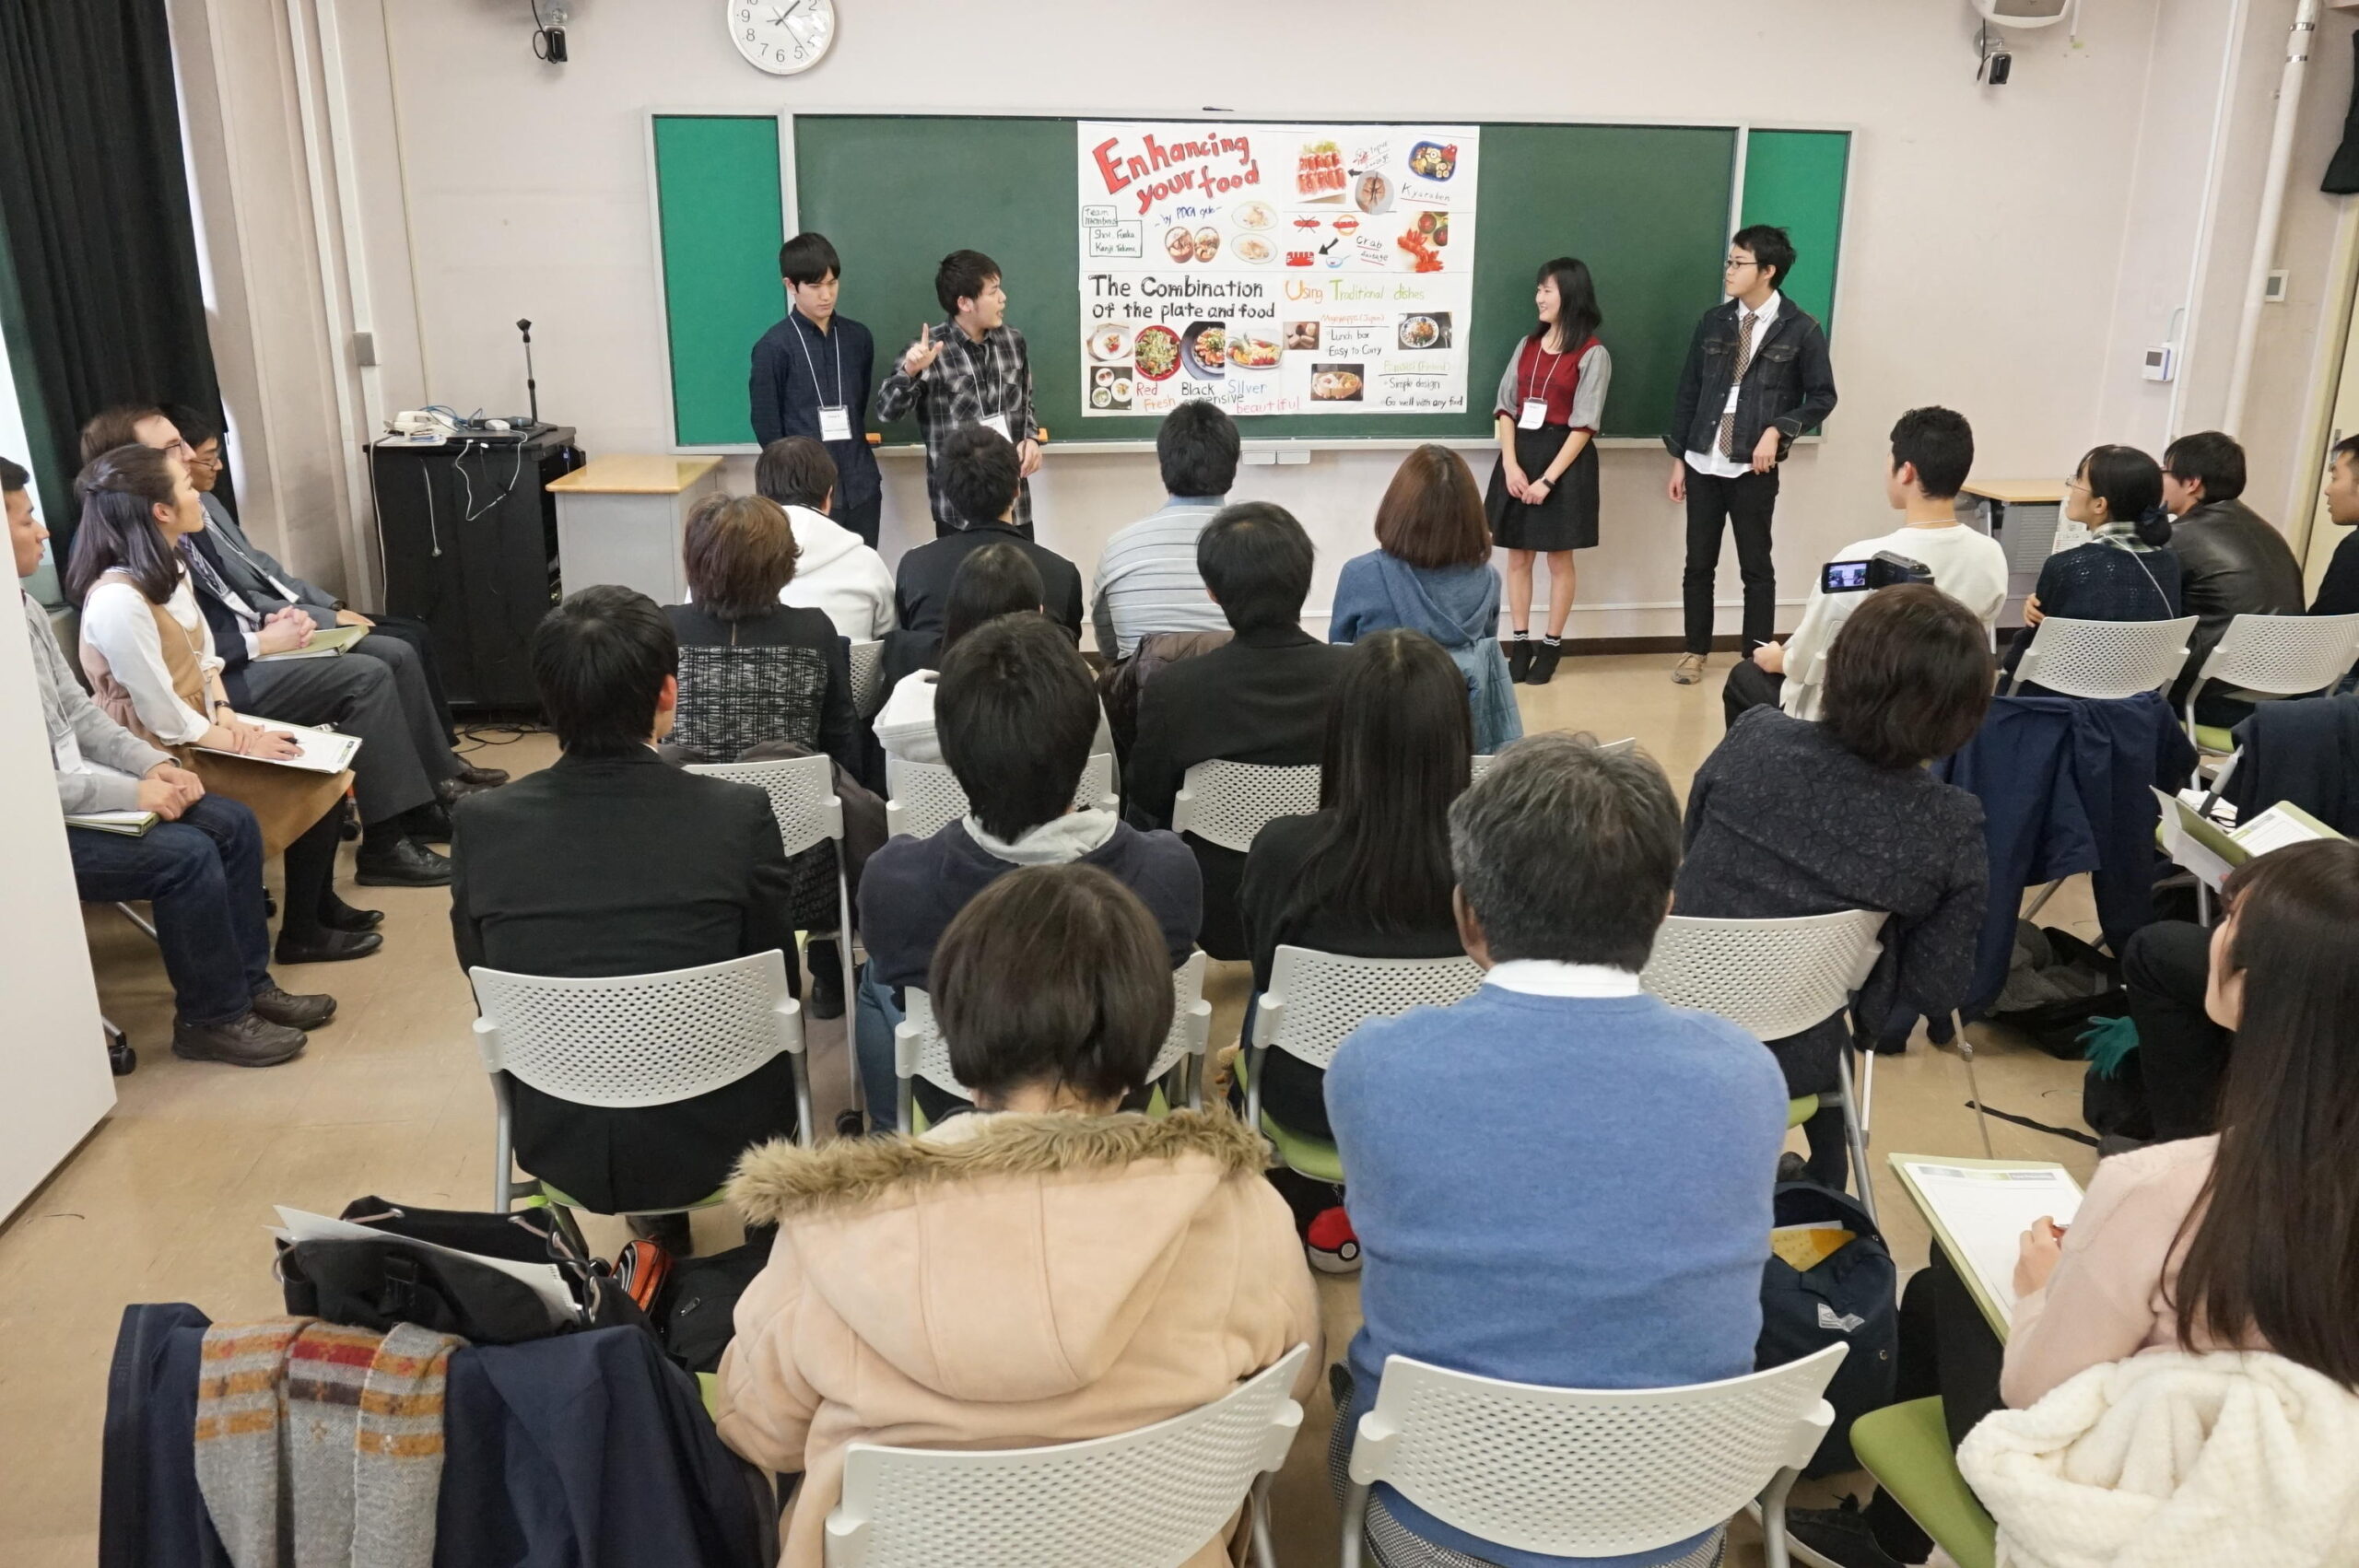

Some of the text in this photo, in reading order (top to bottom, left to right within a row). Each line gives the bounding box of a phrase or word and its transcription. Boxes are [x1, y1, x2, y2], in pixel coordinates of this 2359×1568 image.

[741, 9, 751, 23] 9
[746, 29, 756, 41] 8
[760, 42, 769, 56] 7
[776, 49, 785, 63] 6
[793, 45, 804, 60] 5
[1092, 132, 1250, 195] Enhancing
[1136, 158, 1260, 216] your food
[1088, 274, 1263, 298] The Combination
[1285, 278, 1425, 304] Using Traditional dishes
[1123, 301, 1153, 319] the
[1160, 302, 1203, 323] plate
[1207, 303, 1235, 319] and
[1238, 302, 1275, 319] food
[1331, 328, 1369, 341] Lunch box
[1328, 345, 1349, 358] Easy
[1352, 346, 1360, 355] to
[1136, 381, 1158, 396] Red
[1181, 382, 1215, 396] Black
[1415, 378, 1440, 392] design
[1385, 395, 1464, 410] Go well with any food
